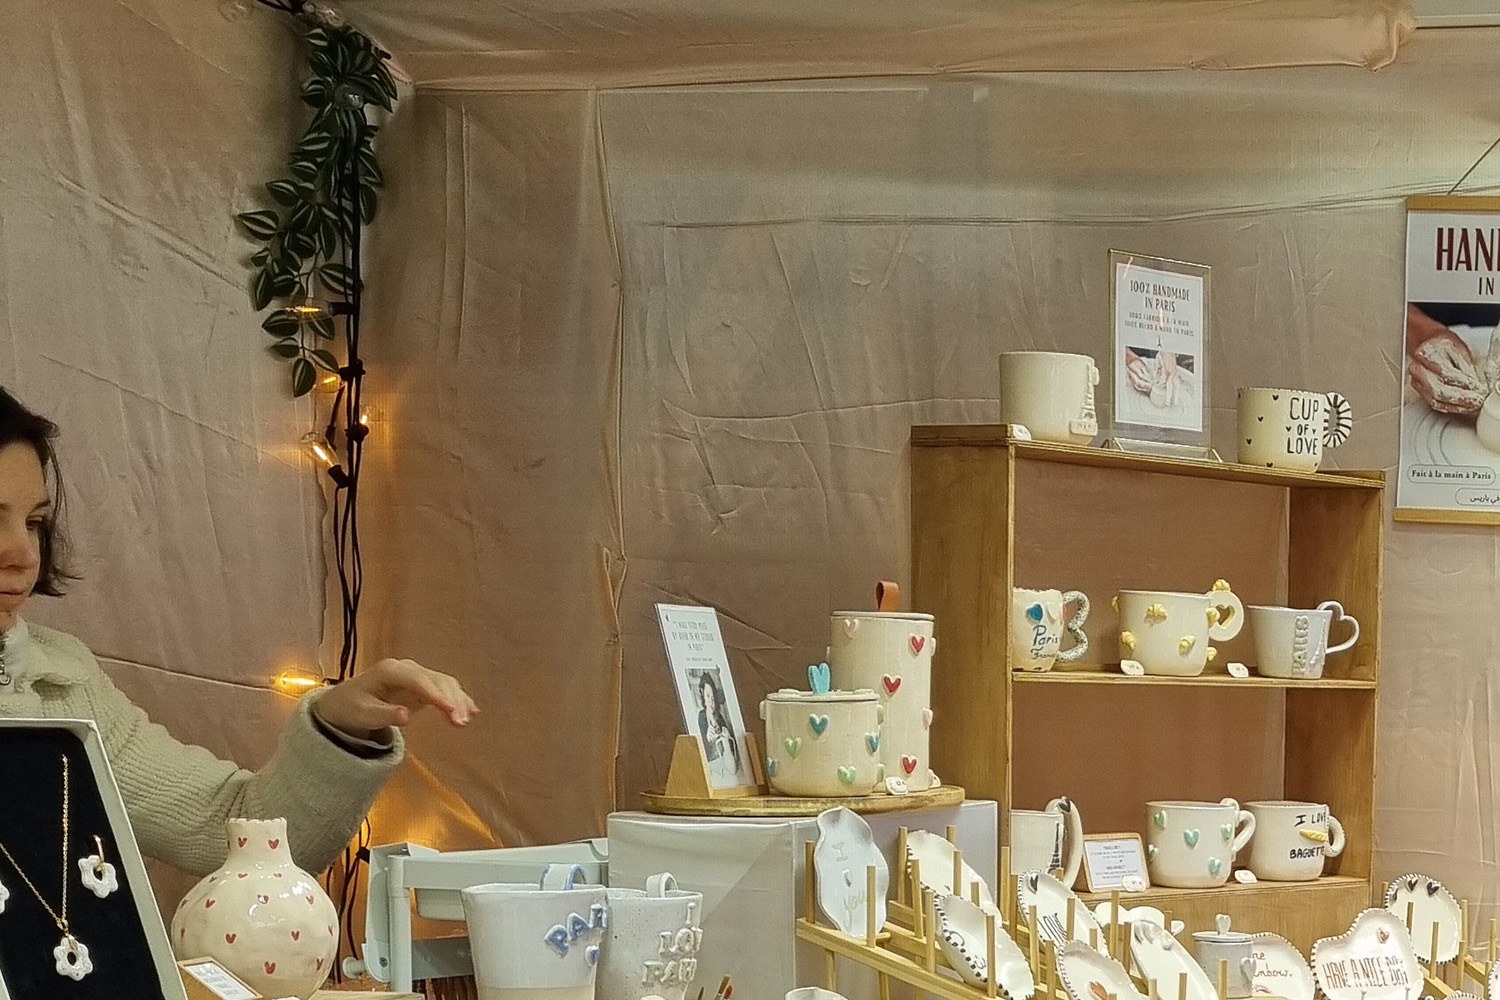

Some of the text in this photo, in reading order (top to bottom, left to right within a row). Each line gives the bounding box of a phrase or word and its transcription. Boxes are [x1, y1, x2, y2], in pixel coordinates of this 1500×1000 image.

[1130, 279, 1190, 301] 100% HANDMADE
[1478, 277, 1494, 296] IN
[1144, 297, 1176, 312] IN PARIS
[1290, 397, 1319, 421] CUP
[1297, 423, 1309, 436] OF
[1287, 437, 1318, 455] LOVE
[1411, 469, 1427, 478] Fait
[1435, 469, 1443, 478] la
[1444, 470, 1464, 480] main
[1472, 472, 1491, 480] Paris
[1033, 625, 1058, 646] Paris
[1294, 811, 1326, 827] I LOVE
[1322, 960, 1352, 989] HAVE
[1350, 958, 1362, 987] A
[1360, 957, 1388, 987] NICE
